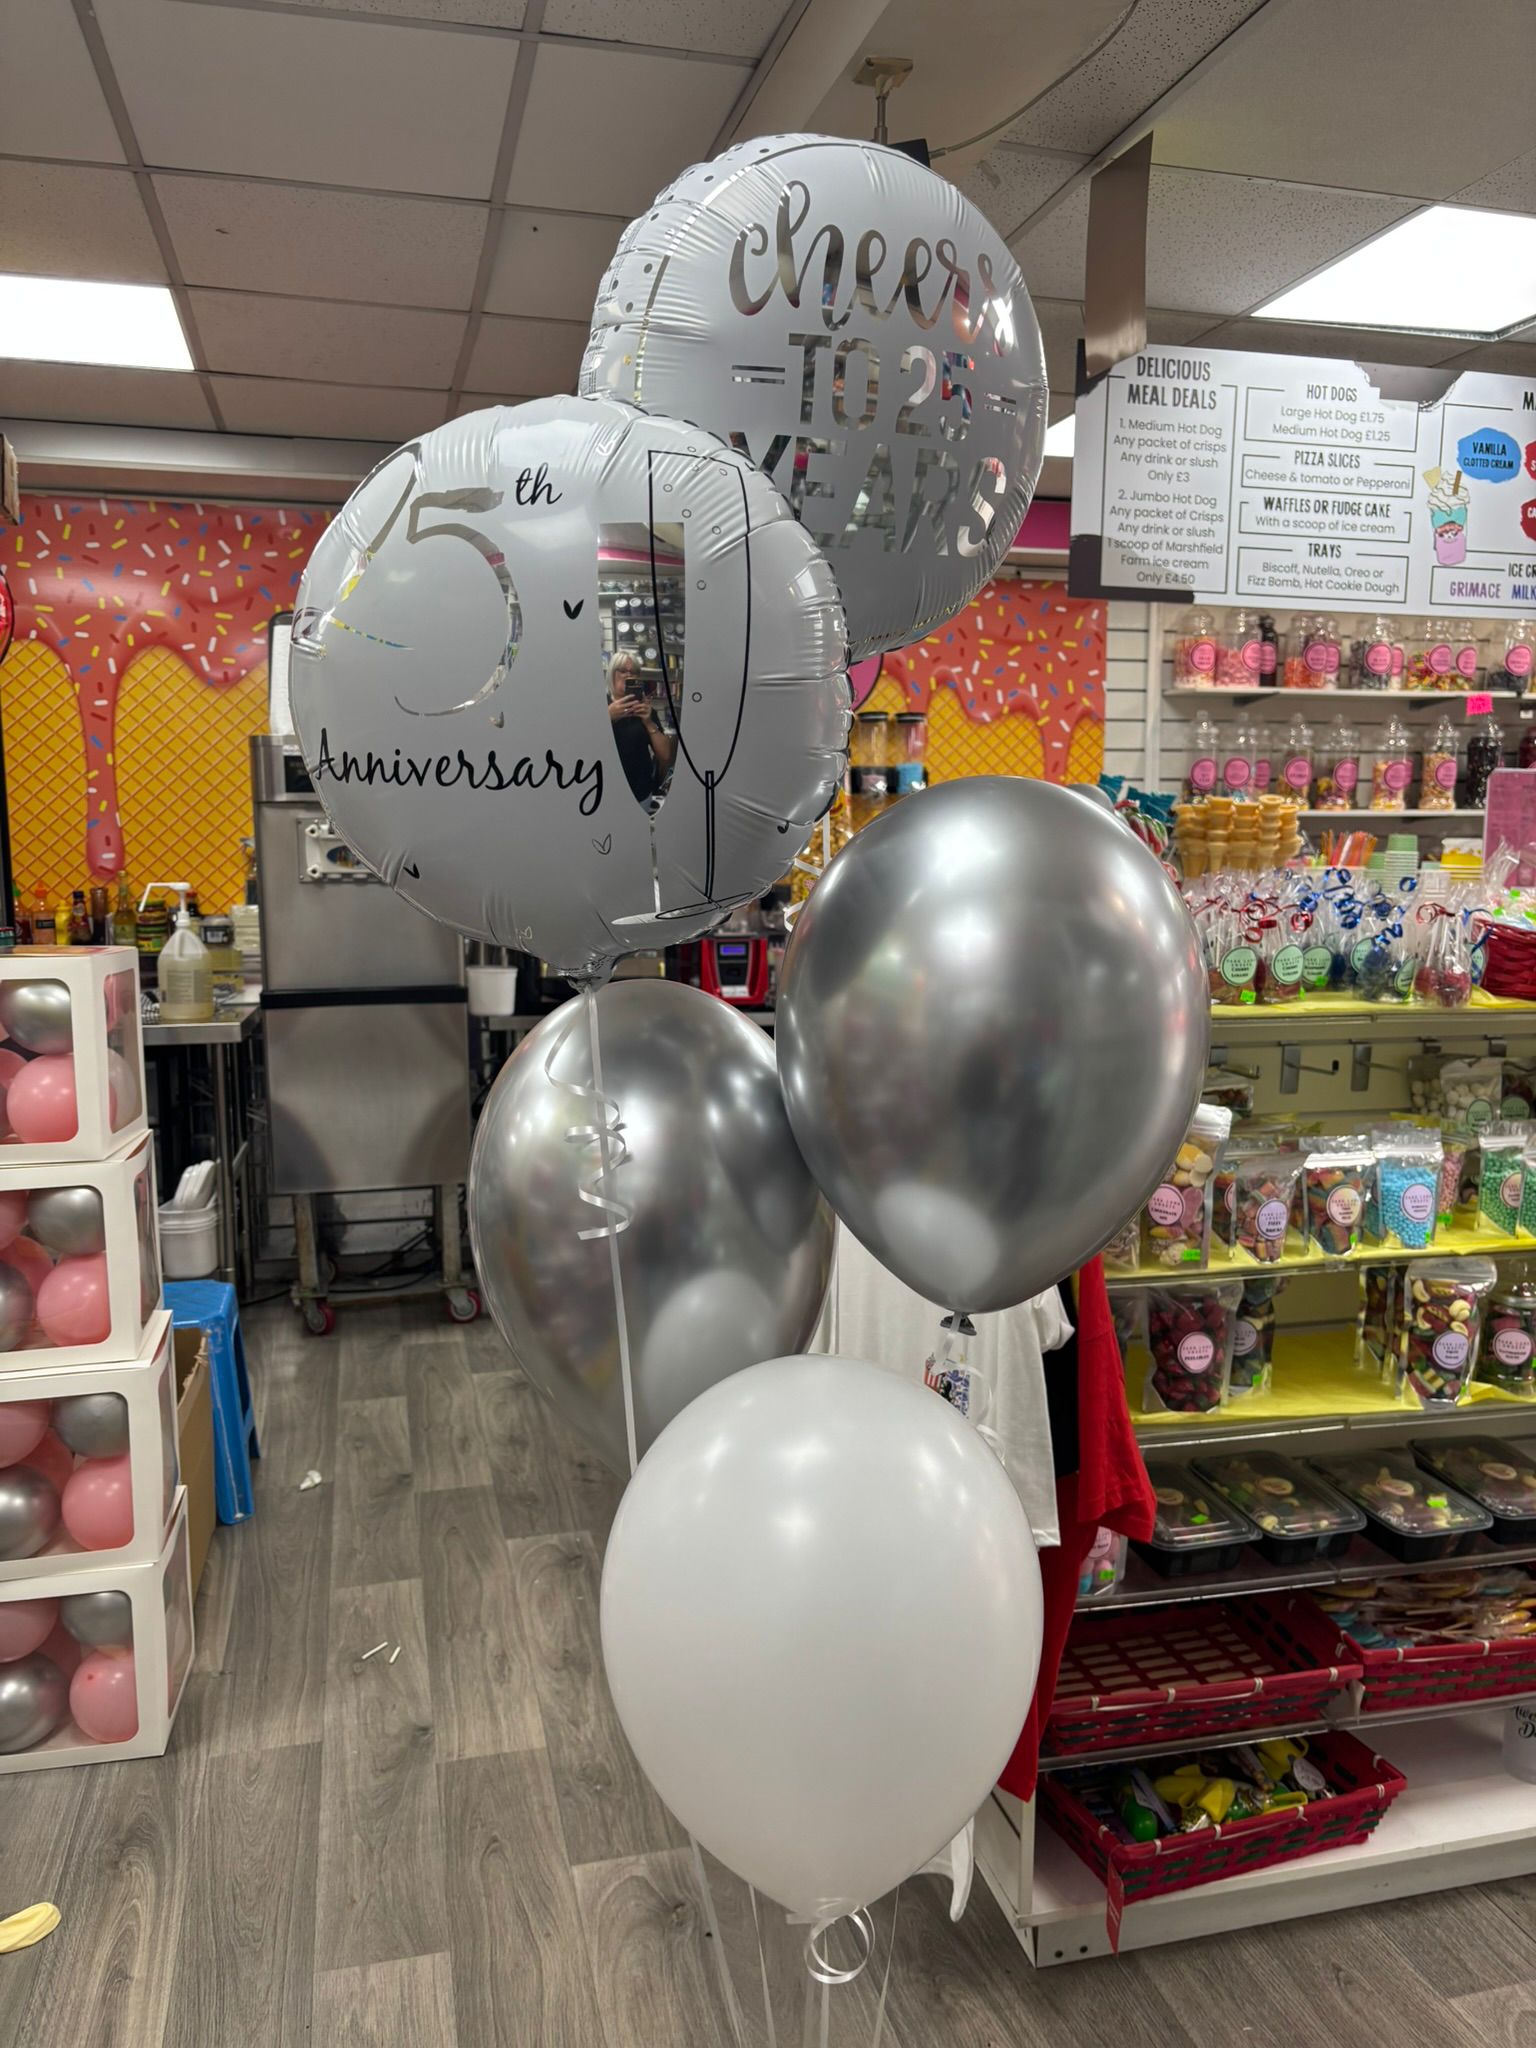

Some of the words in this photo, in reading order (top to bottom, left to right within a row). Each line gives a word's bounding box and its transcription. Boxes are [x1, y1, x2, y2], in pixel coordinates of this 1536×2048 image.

[729, 180, 1014, 357] cheers
[1136, 355, 1212, 382] DELICIOUS
[788, 333, 880, 432] TO
[895, 345, 975, 442] 25
[1127, 383, 1168, 407] MEAL
[1172, 387, 1217, 411] DEALS
[1306, 383, 1329, 400] HOT
[1330, 386, 1358, 403] DOGS
[1280, 405, 1313, 421] Large
[1314, 408, 1333, 420] Hot
[1335, 409, 1358, 425] Dog
[1359, 411, 1385, 424] £1.75
[1128, 419, 1176, 433] Medium
[1177, 422, 1197, 434] Hot
[1200, 424, 1222, 439] Dog
[1272, 423, 1317, 437] Medium
[1320, 427, 1339, 439] Hot
[1340, 428, 1363, 443] Dog
[1365, 430, 1391, 442] £1.25
[1113, 434, 1135, 449] Any
[1137, 437, 1177, 450] packet
[1179, 439, 1192, 450] of
[1193, 440, 1227, 455] crisps
[1472, 442, 1507, 457] VANILLA
[1120, 451, 1142, 466] Any
[1144, 452, 1173, 465] drink
[1174, 456, 1187, 466] or
[1189, 456, 1219, 469] slush
[1294, 450, 1325, 467] PIZZA
[1327, 452, 1361, 469] SLICES
[1463, 457, 1490, 468] CLOTTED
[1490, 459, 1514, 470] CREAM
[1147, 469, 1174, 485] Only
[1176, 471, 1191, 483] £3
[1245, 469, 1288, 482] Cheese
[1289, 472, 1298, 482] &
[1300, 472, 1341, 486] tomato
[1342, 476, 1355, 487] or
[1356, 476, 1411, 491] Pepperoni
[728, 431, 1006, 558] YEARS
[1129, 490, 1171, 503] Jumbo
[1172, 493, 1193, 505] Hot
[1194, 495, 1217, 510] Dog
[1109, 505, 1132, 520] Any
[1133, 507, 1174, 520] packet
[1175, 509, 1188, 521] of
[1189, 510, 1225, 525] Crisps
[1263, 496, 1311, 513] WAFFLES
[1313, 499, 1329, 515] OR
[1331, 500, 1362, 517] FUDGE
[1364, 502, 1391, 519] CAKE
[1118, 522, 1141, 537] Any
[1141, 523, 1171, 536] drink
[1171, 527, 1184, 537] or
[1186, 526, 1216, 539] slush
[1255, 515, 1281, 527] With
[1281, 518, 1291, 528] a
[1292, 518, 1327, 533] scoop
[1328, 519, 1340, 531] of
[1341, 521, 1358, 532] ice
[1359, 523, 1396, 534] cream
[1113, 539, 1150, 553] scoop
[1151, 540, 1164, 551] of
[1165, 541, 1224, 555] Marshfield
[1308, 543, 1342, 559] TRAYS
[1120, 554, 1151, 567] Farm
[1152, 555, 1171, 568] ice
[1171, 559, 1210, 570] cream
[1344, 566, 1371, 578] Oreo
[1372, 569, 1384, 578] or
[1508, 562, 1524, 578] ICE
[1136, 571, 1163, 586] Only
[1247, 574, 1266, 587] Fizz
[1304, 578, 1323, 590] Hot
[1326, 580, 1363, 592] Cookie
[1364, 582, 1400, 597] Dough
[1450, 581, 1501, 599] GRIMACE
[315, 727, 604, 816] Anniversary
